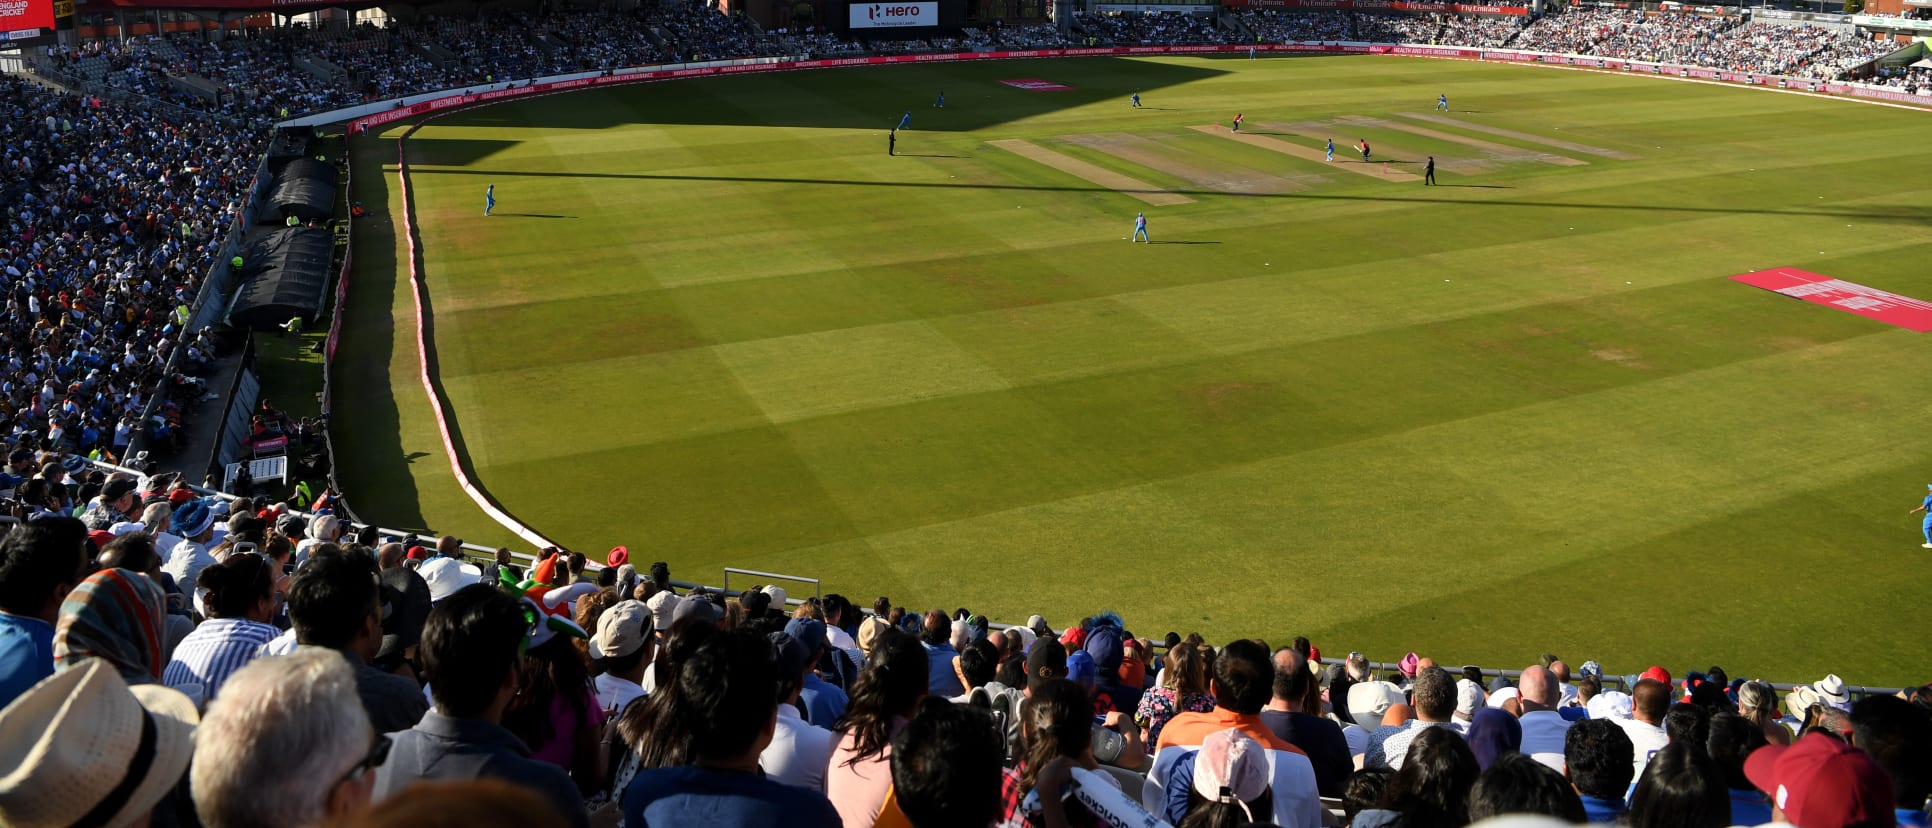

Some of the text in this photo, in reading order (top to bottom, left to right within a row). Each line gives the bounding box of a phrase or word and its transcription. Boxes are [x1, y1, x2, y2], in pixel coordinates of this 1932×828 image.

[0, 1, 28, 9] ENGLAND
[886, 6, 919, 16] Hero
[1856, 88, 1876, 98] HEALTH
[1891, 92, 1903, 100] LIFE
[430, 96, 462, 108] INVESTMENTS
[378, 115, 388, 124] LIFE
[388, 108, 412, 120] INSURANCE
